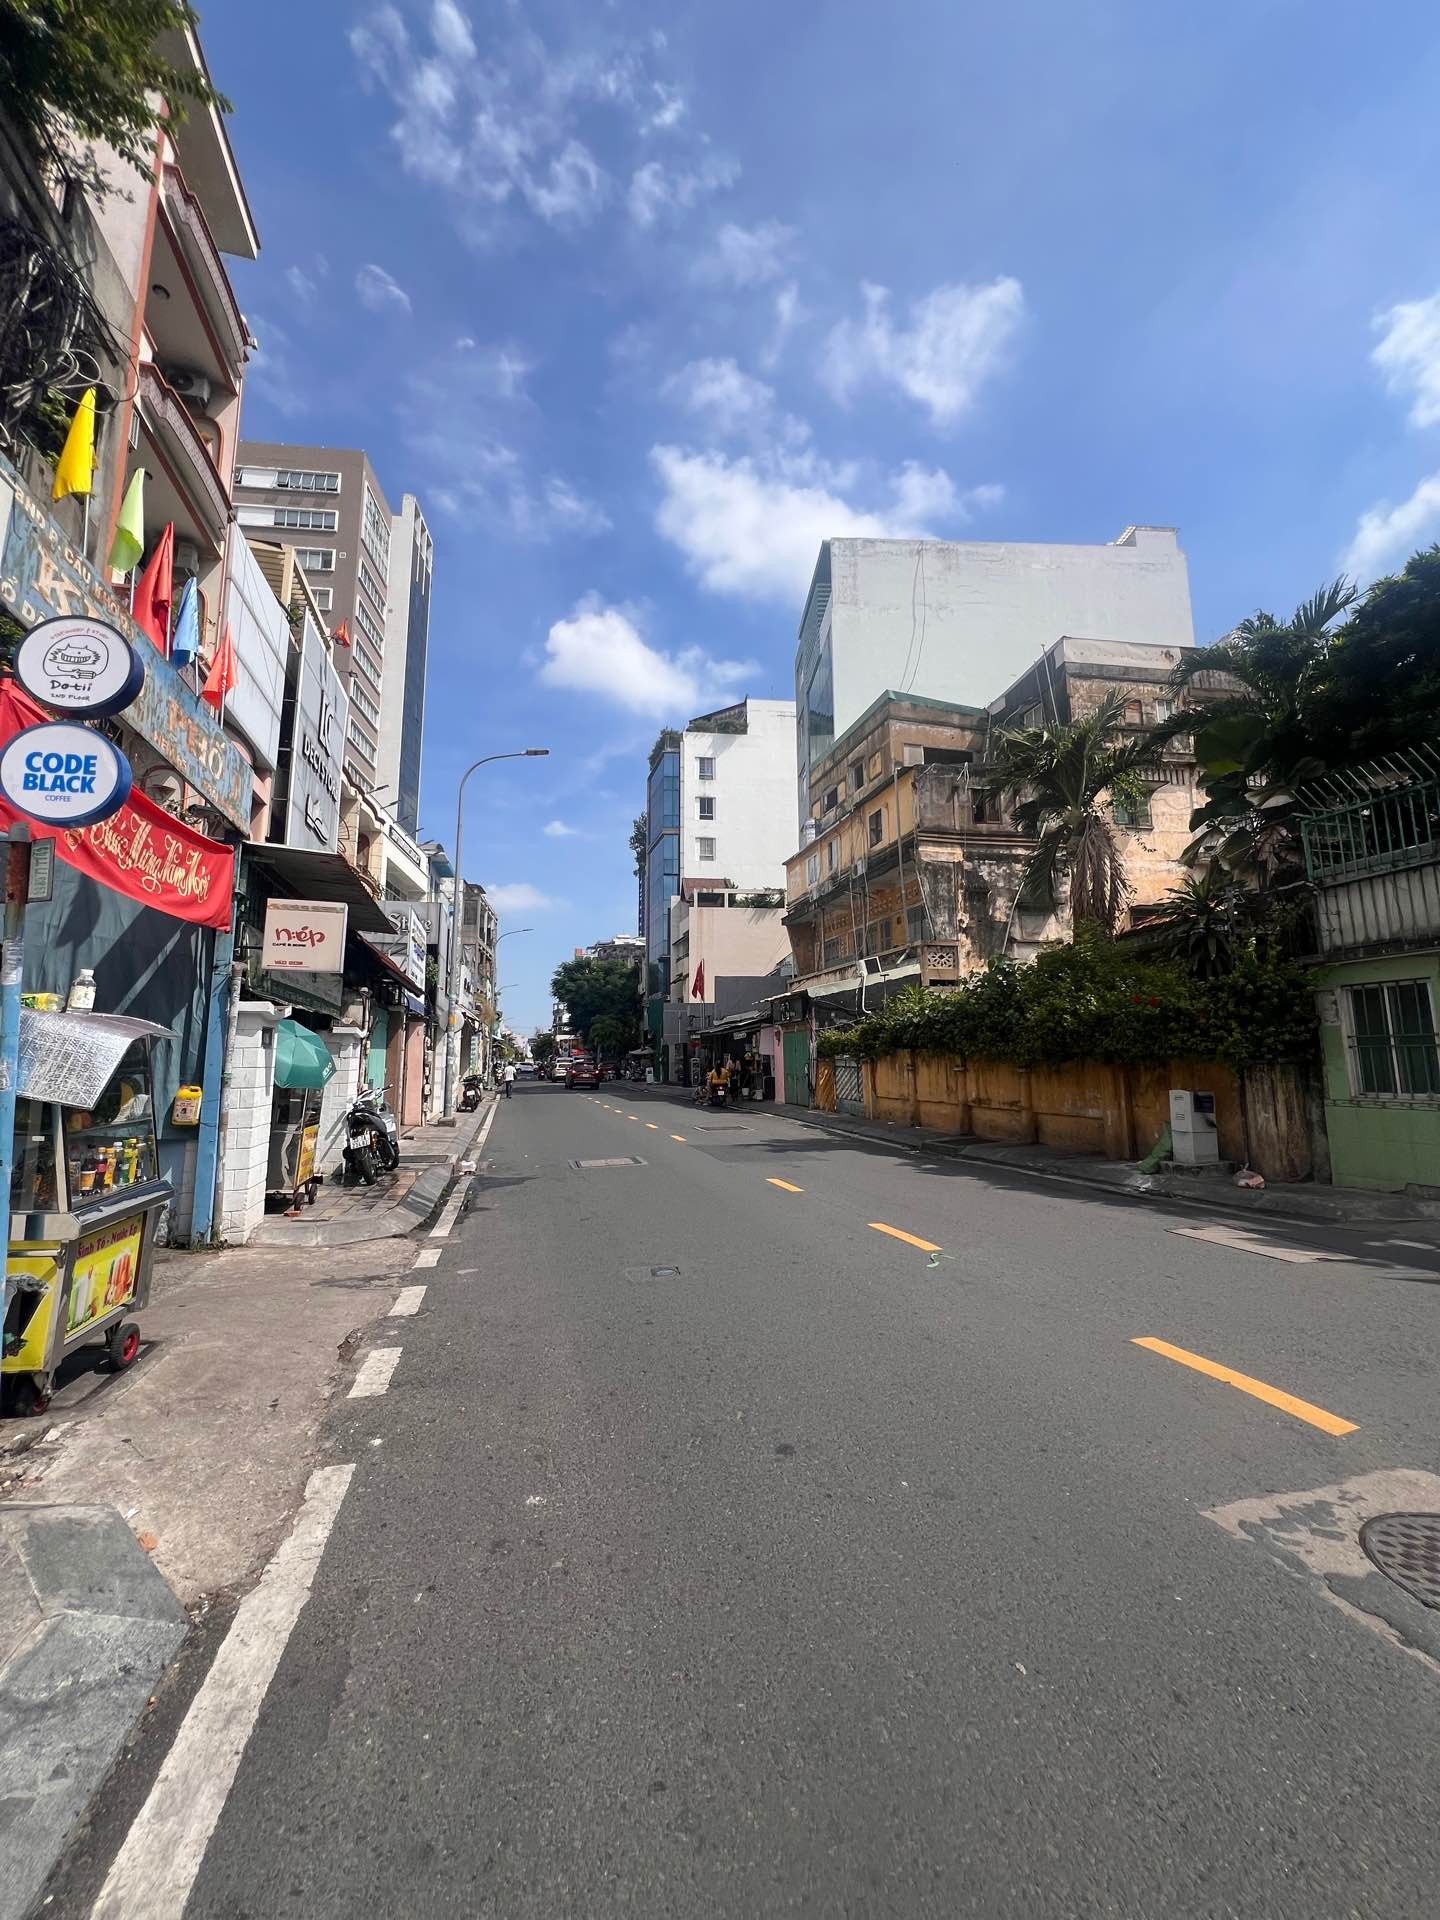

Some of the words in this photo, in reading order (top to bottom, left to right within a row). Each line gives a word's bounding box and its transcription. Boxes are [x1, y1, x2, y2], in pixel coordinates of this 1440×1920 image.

[25, 751, 98, 775] CODE
[22, 773, 96, 794] BLACK
[44, 794, 72, 803] COFFEE
